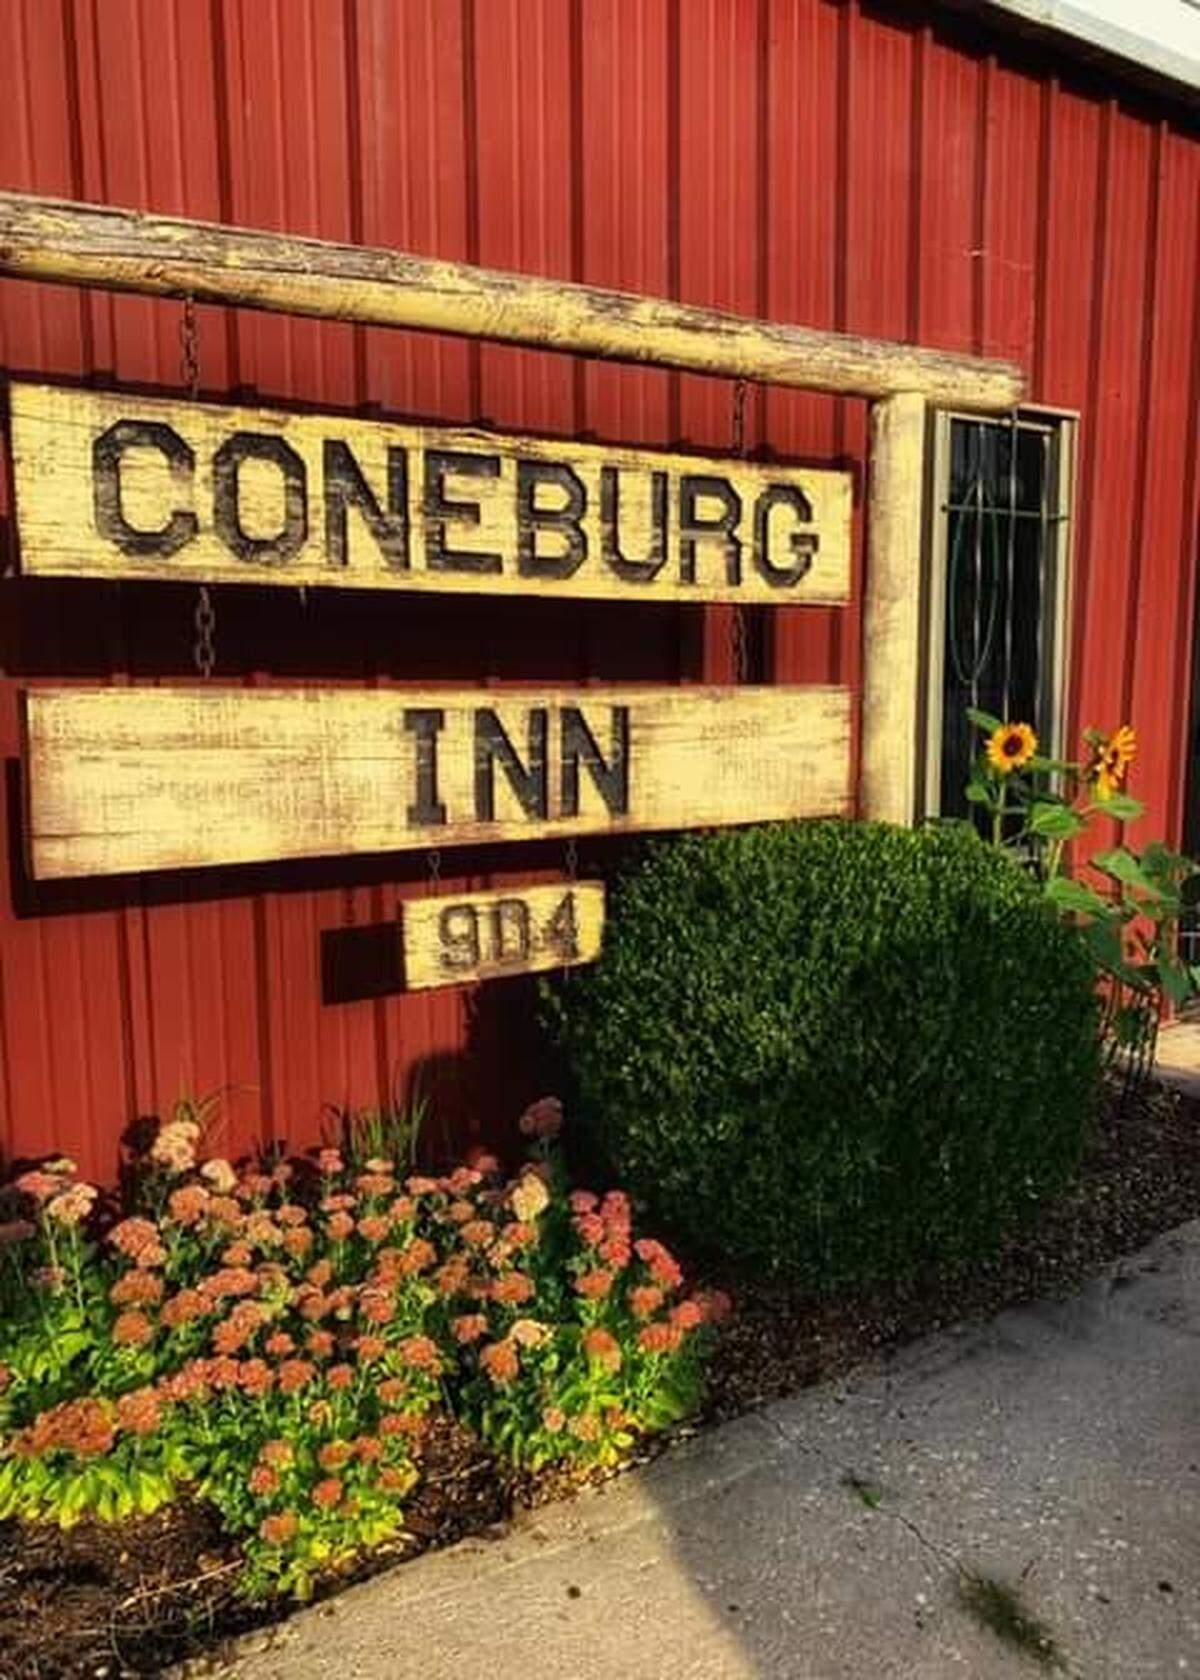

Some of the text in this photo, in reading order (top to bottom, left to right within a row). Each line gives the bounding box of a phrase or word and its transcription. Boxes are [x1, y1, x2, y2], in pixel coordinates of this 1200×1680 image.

[91, 418, 820, 588] CONEBURG
[403, 705, 631, 827] INN
[438, 889, 580, 972] 904
